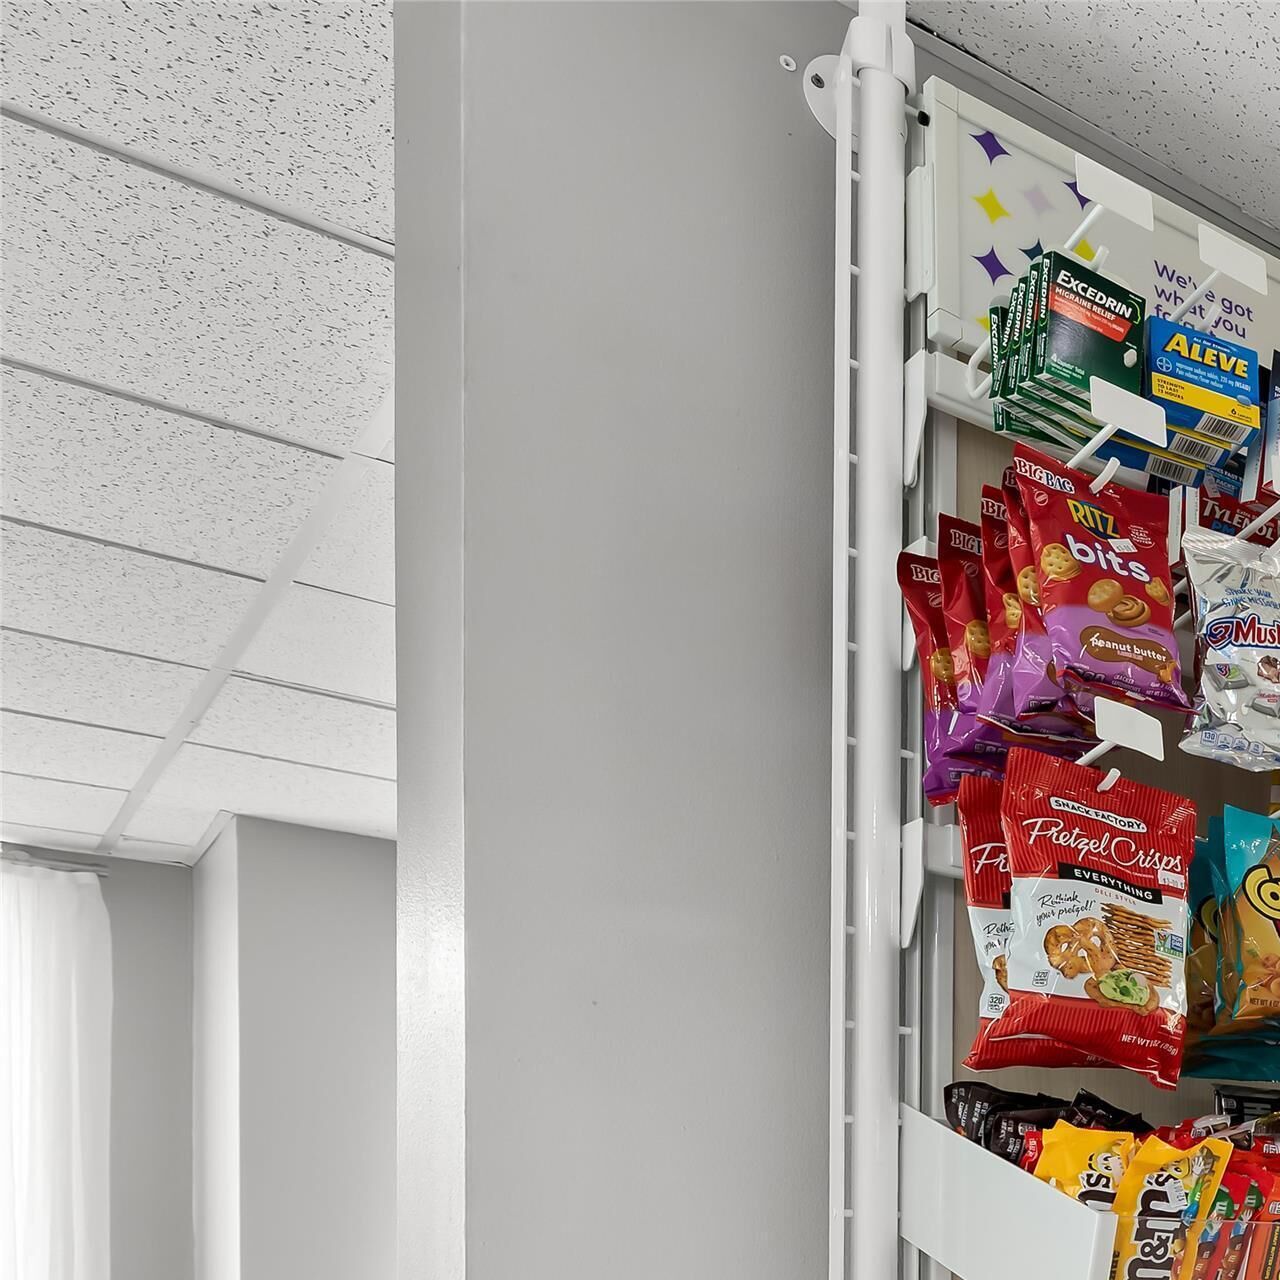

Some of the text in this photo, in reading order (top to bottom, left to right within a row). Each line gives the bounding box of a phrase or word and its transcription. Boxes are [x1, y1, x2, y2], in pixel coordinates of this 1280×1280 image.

[1025, 270, 1038, 329] EXCEDRIN
[1040, 257, 1050, 319] EXCEDRIN
[1055, 286, 1117, 321] MIGRAINE RELIEF
[1056, 269, 1132, 318] EXCEDRIN
[1012, 282, 1026, 342] EXCEDRIN
[1221, 297, 1254, 322] got
[1212, 316, 1246, 339] you
[1164, 332, 1249, 378] ALEVE
[1157, 378, 1185, 390] STRENGTH
[1014, 456, 1075, 494] BIG BAG
[1066, 498, 1121, 539] RITZ
[1065, 534, 1151, 583] bits
[1091, 635, 1167, 662] peanut butter
[1208, 624, 1231, 643] 3
[1204, 732, 1215, 741] 130
[1054, 799, 1145, 831] SNACK FACTORY
[1022, 817, 1110, 861] Pretzel
[1111, 837, 1182, 871] Crisps
[1073, 868, 1153, 900] EVERYTHING
[1094, 887, 1137, 905] DELI STYLE
[1036, 900, 1095, 926] your pretzel!
[989, 995, 1003, 1004] 320
[1121, 1034, 1150, 1047] NET WT
